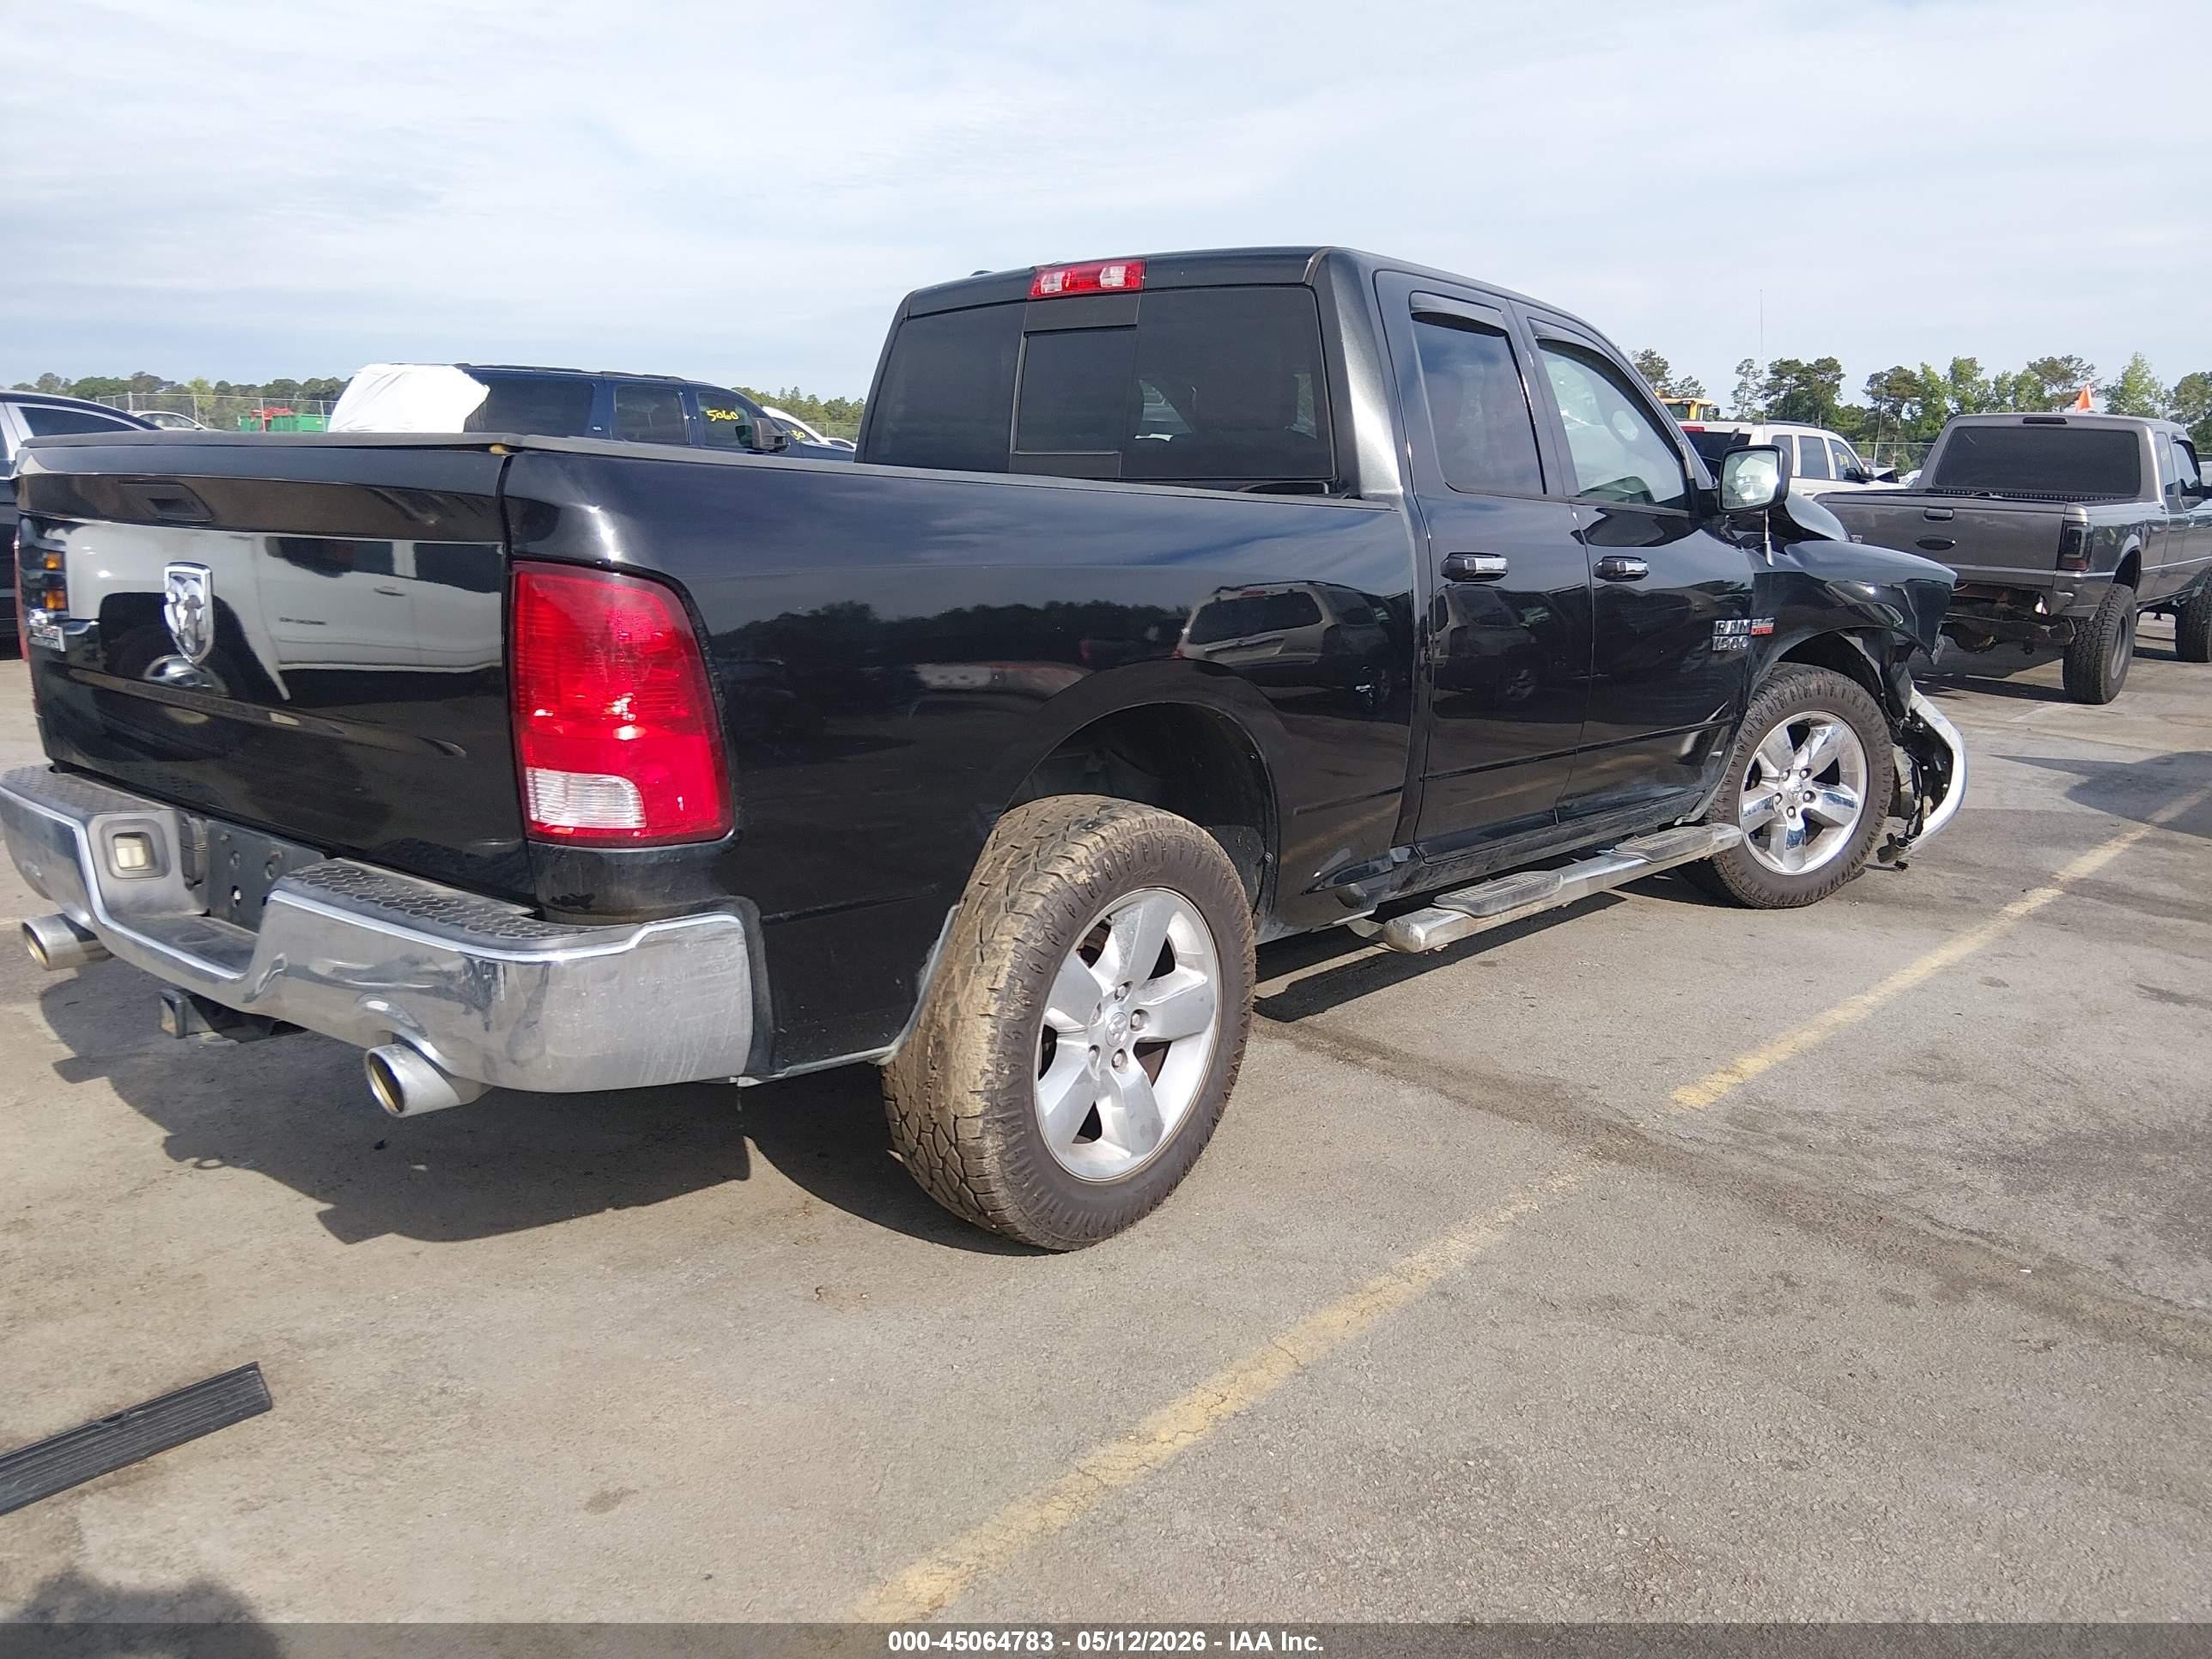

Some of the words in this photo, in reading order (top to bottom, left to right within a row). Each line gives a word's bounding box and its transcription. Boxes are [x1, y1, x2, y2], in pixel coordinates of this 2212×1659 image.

[707, 409, 739, 422] 5060
[1714, 619, 1751, 635] RAM
[1712, 635, 1748, 651] 1500
